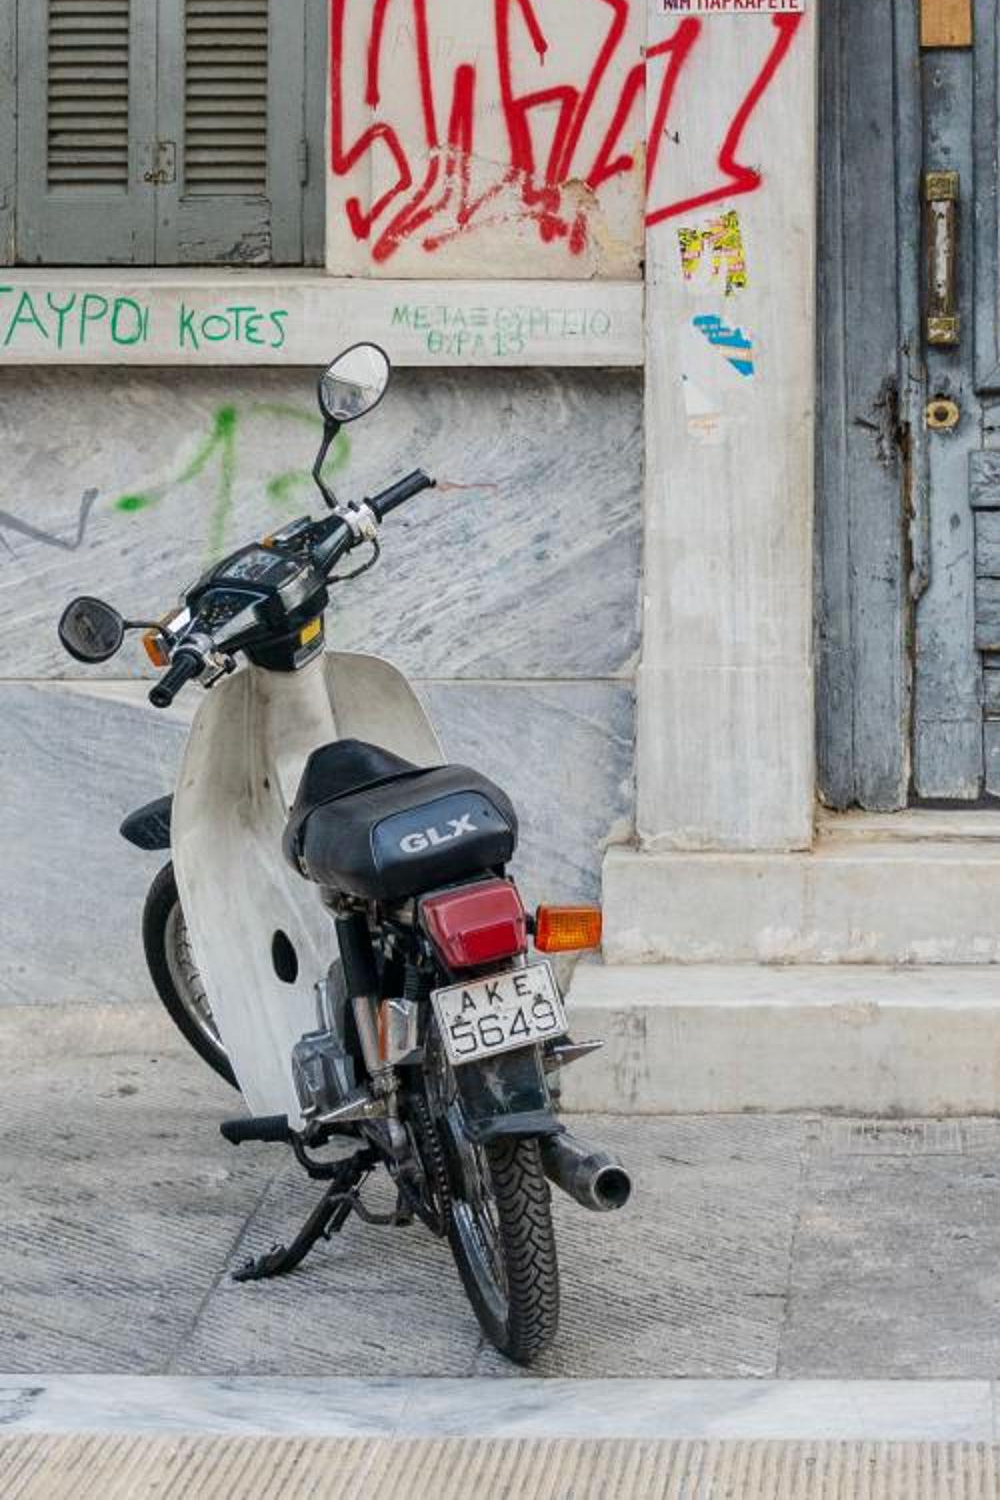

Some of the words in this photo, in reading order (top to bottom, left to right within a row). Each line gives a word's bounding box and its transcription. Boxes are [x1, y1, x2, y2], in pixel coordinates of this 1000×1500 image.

[0, 286, 149, 350] ΑΥΡΟΙ
[400, 813, 478, 853] GLX
[449, 999, 557, 1054] 5649
